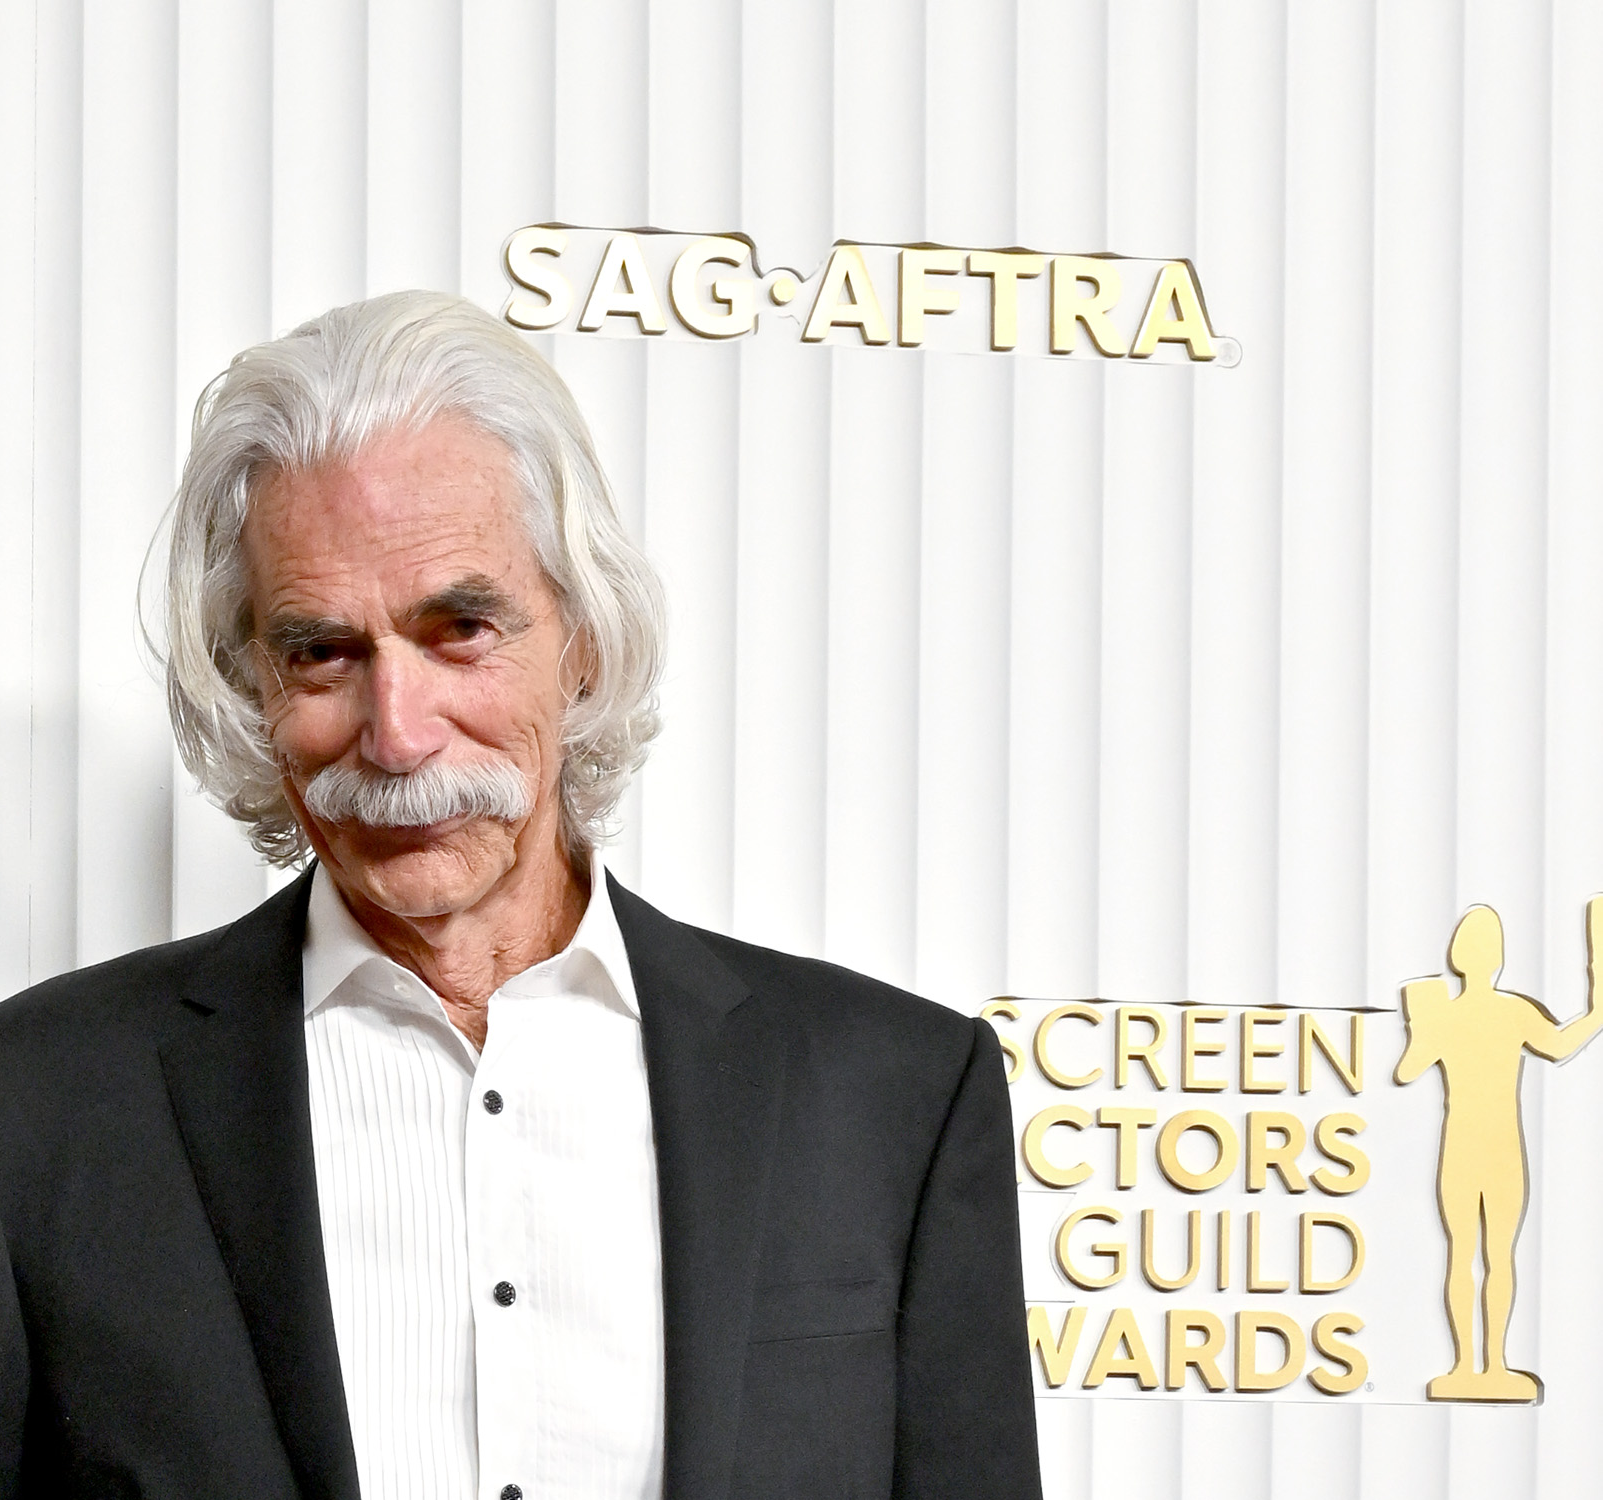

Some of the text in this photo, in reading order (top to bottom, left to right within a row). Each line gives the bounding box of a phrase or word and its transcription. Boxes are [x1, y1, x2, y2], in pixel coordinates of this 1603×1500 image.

[980, 1001, 1365, 1095] SCREEN
[1017, 1104, 1372, 1196] CTORS
[1056, 1205, 1367, 1295] GUILD
